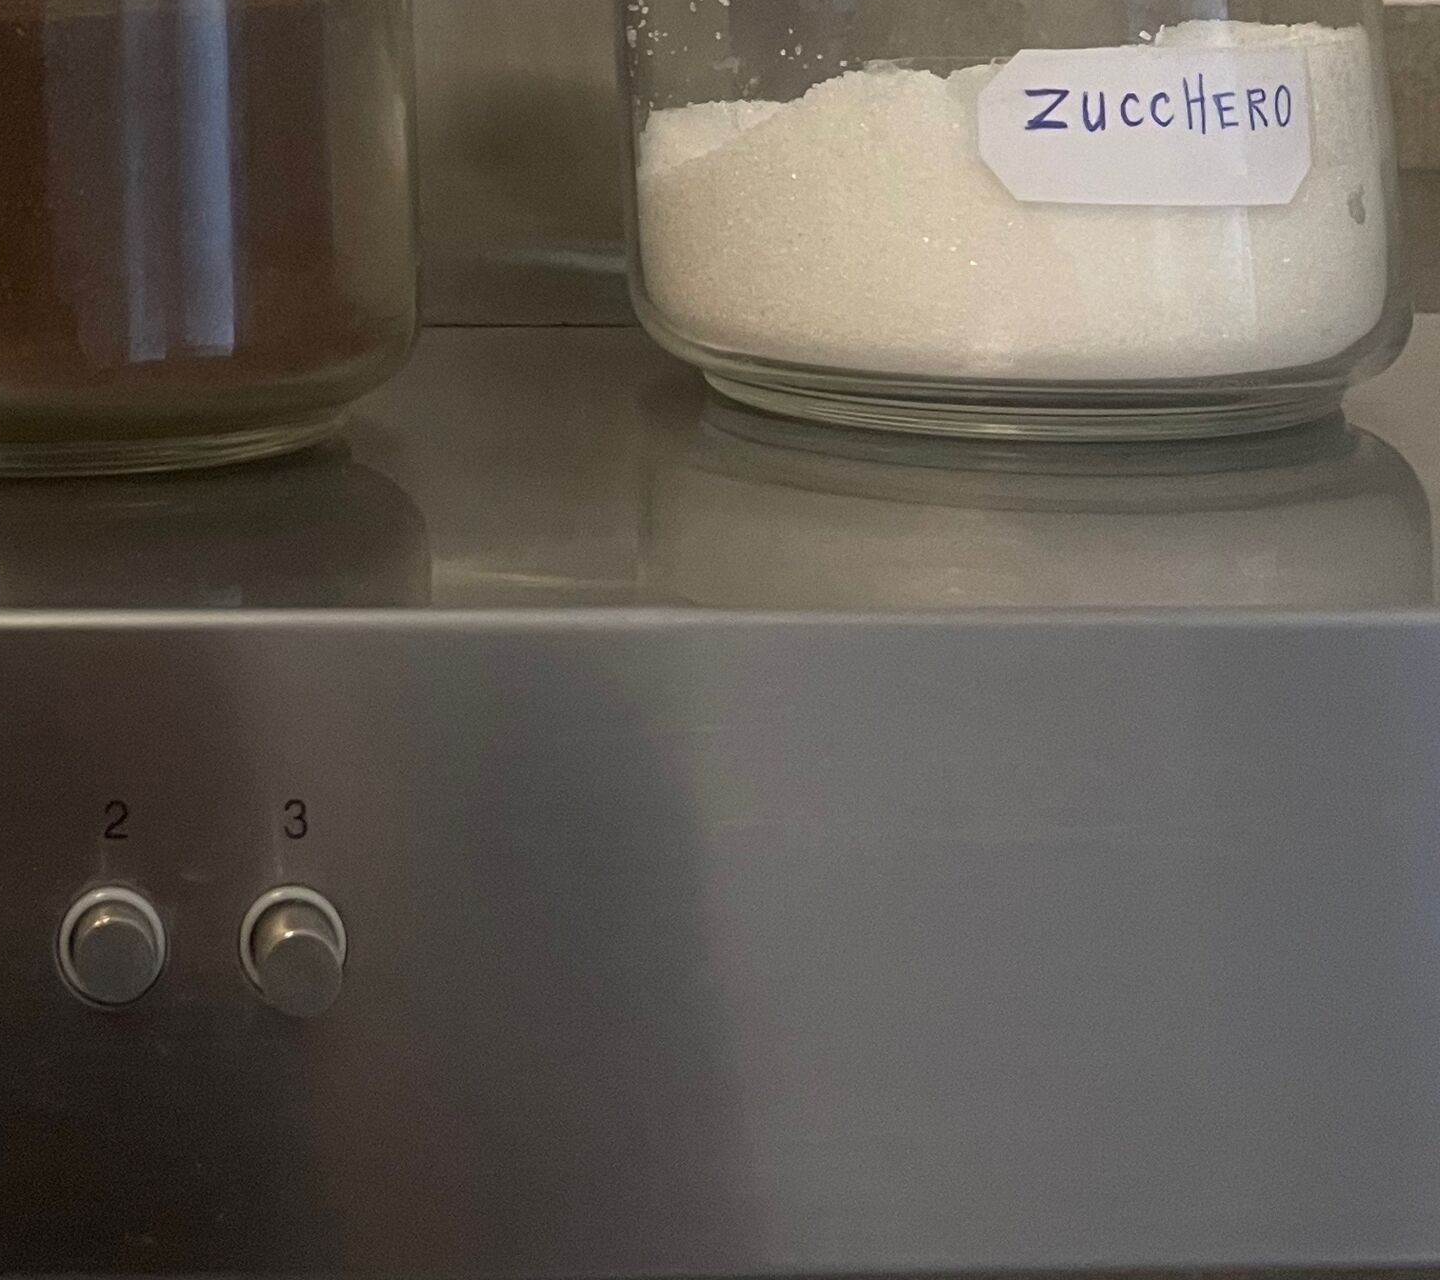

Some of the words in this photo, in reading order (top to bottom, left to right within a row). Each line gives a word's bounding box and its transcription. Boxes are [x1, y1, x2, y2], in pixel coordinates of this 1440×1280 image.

[1023, 72, 1293, 135] ZUCCHERO
[103, 800, 130, 840] 2
[283, 799, 309, 840] 3
